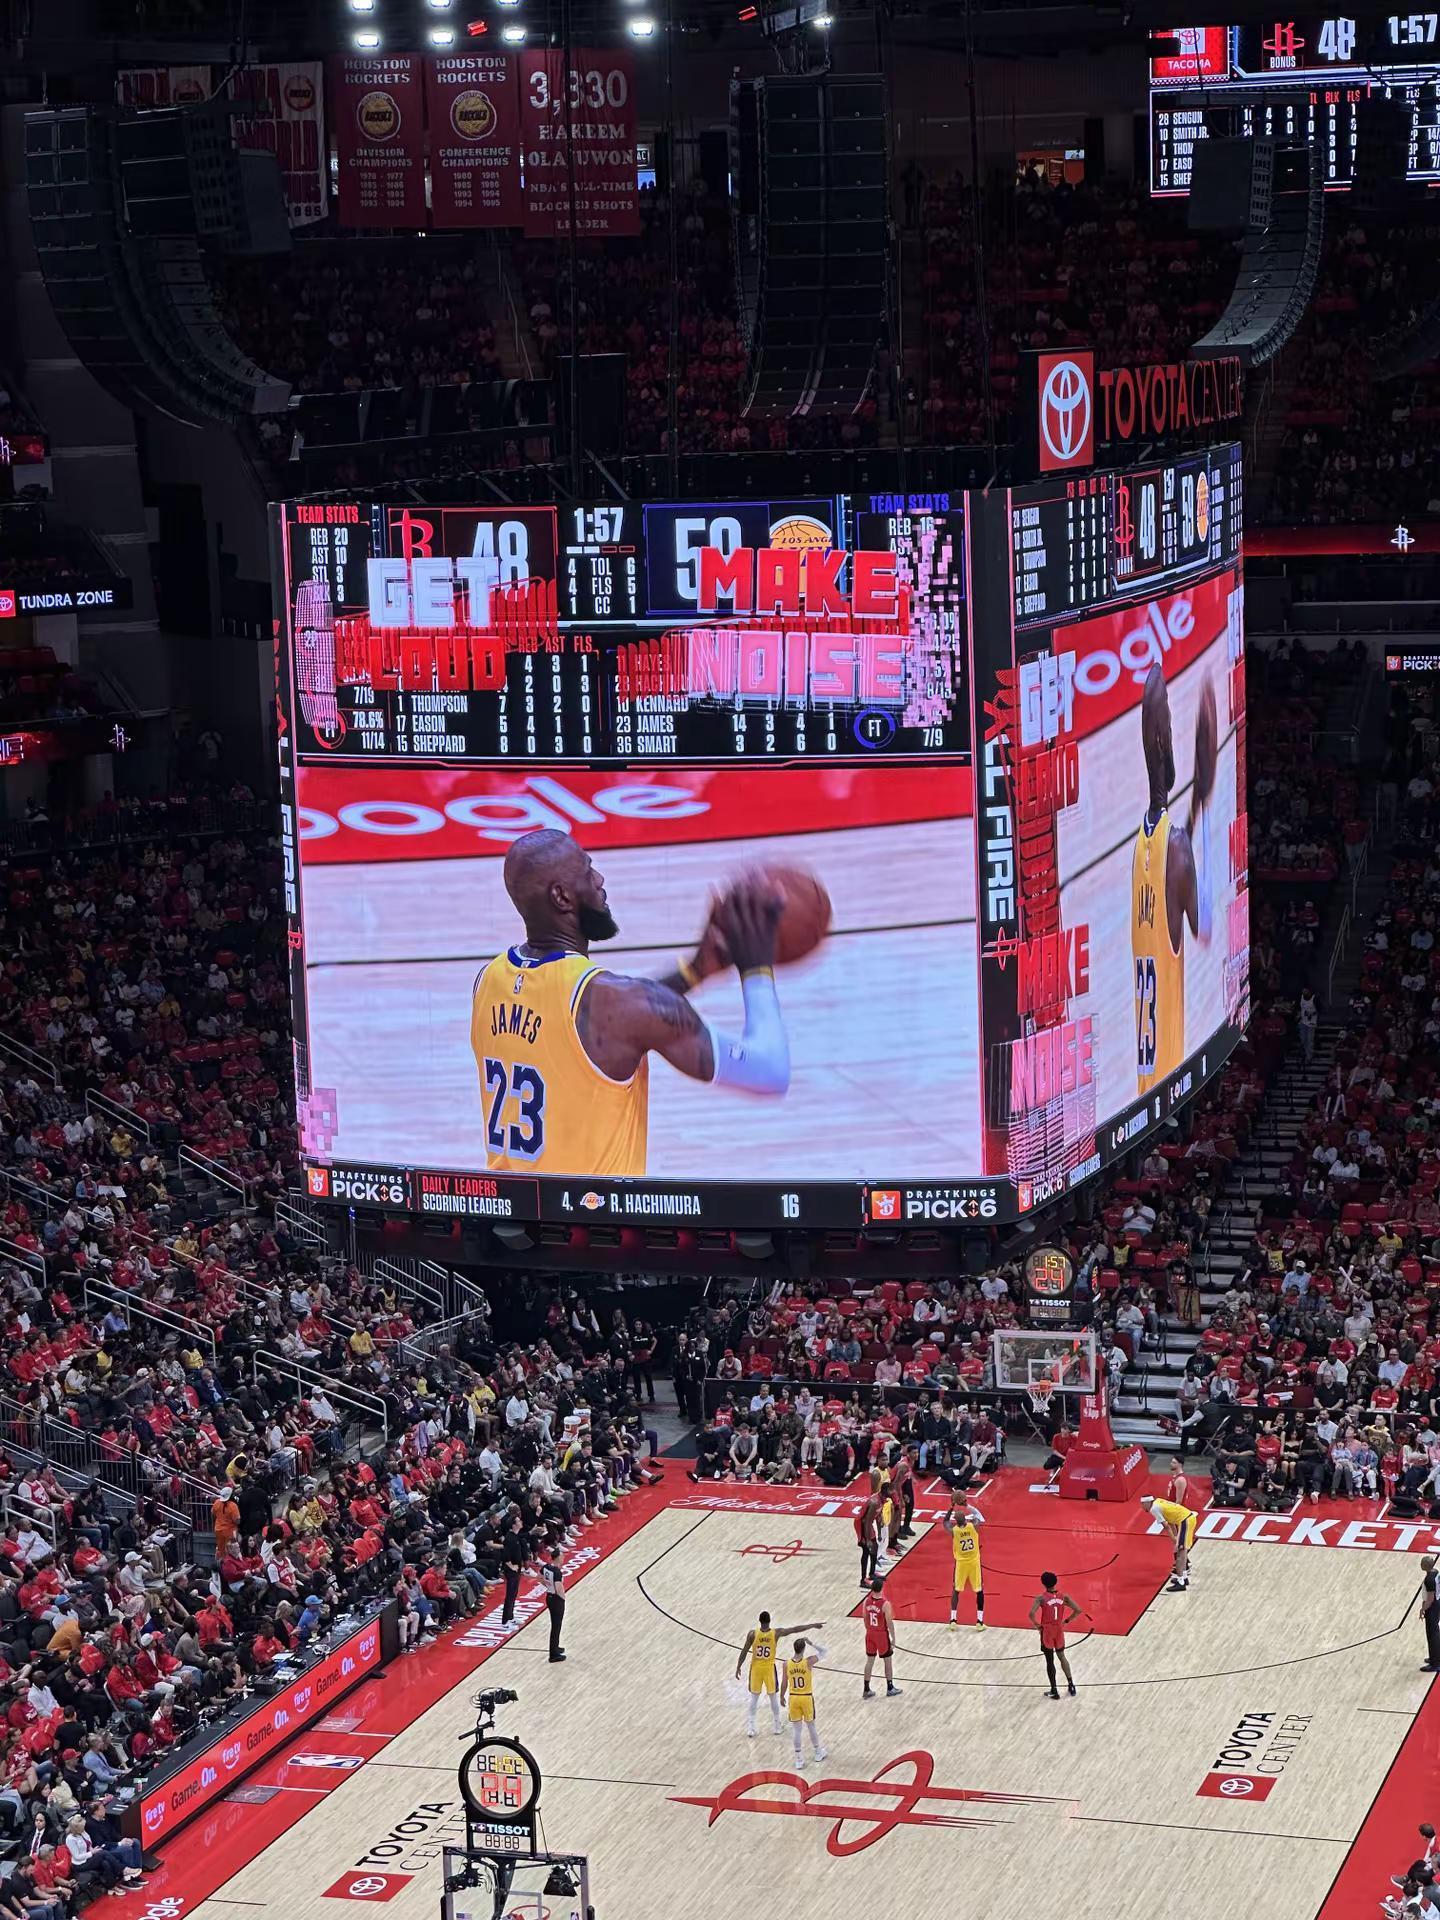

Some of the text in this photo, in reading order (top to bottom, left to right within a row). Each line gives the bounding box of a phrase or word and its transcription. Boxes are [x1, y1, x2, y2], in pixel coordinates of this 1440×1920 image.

[1318, 14, 1438, 60] 48 1:57
[344, 59, 411, 70] HOUSTON
[436, 57, 506, 70] HOUSTON
[1168, 59, 1211, 69] TACOMA
[1270, 56, 1296, 68] BONUS
[345, 73, 411, 84] ROCKETS
[437, 72, 506, 84] ROCKETS
[538, 123, 625, 140] HAKEEM
[1173, 126, 1197, 140] SMITH
[356, 148, 405, 157] DIVISION
[439, 146, 511, 157] CONFERENCE
[349, 158, 413, 167] CHAMPIONS
[442, 157, 509, 168] CHAMPIONS
[593, 200, 634, 211] SHOTS
[1099, 356, 1242, 441] TOYOTA CENTER
[870, 494, 950, 514] TEAM STATS
[297, 506, 359, 523] TEAM STATS
[1140, 483, 1156, 560] 48
[573, 507, 624, 542] 1:57
[888, 517, 912, 536] REB
[310, 527, 349, 546] REB 20
[311, 546, 348, 564] AST 10
[312, 565, 344, 583] STL 3
[567, 557, 636, 576] 4 TOL 6
[568, 576, 636, 595] 4 FLS 5
[696, 546, 901, 619] MAKE
[19, 590, 113, 610] TUNDRA ZONE
[337, 584, 345, 602] 3
[366, 557, 499, 628] GET
[570, 596, 636, 615] 1 CC 1
[545, 636, 593, 653] AST FLS
[367, 636, 507, 691] LOUD
[524, 655, 588, 673] 4 3 1
[688, 628, 908, 704] NOISE
[1403, 660, 1433, 671] PICK
[525, 675, 590, 693] 2 0 3
[353, 686, 375, 704] 7/19
[398, 695, 590, 713] 1 THOMPSON 7 3 2 0
[636, 694, 690, 713] KENNARD
[352, 711, 384, 729] 78.6%
[396, 714, 590, 733] 17 EASON 5 4 1 1
[616, 712, 834, 733] 23 JAMES 14 3 4 1
[868, 719, 881, 737] FT
[361, 731, 385, 750] 11/14
[396, 734, 592, 753] 15 SHEPPARD 8 0 3 0
[616, 733, 836, 753] 36 SMART 3 2 6 0
[923, 729, 943, 746] 7/9
[986, 805, 1015, 921] FIRE
[1017, 923, 1090, 1016] MAKE
[490, 1002, 542, 1045] JAMES
[1136, 956, 1157, 1076] 23
[1012, 1015, 1093, 1113] NOISE
[483, 1056, 547, 1162] 23
[332, 1170, 403, 1184] DRAFTKINGS
[422, 1175, 497, 1197] DAILY LEADERS
[332, 1181, 379, 1202] PICK
[906, 1188, 996, 1199] DRAFTKINGS
[422, 1193, 512, 1217] SCORING LEADERS
[561, 1191, 574, 1211] 4.
[624, 1193, 701, 1215] HACHIMURA
[781, 1193, 800, 1218] 16
[906, 1199, 968, 1219] PICK
[1034, 1267, 1064, 1292] 24
[669, 1495, 811, 1513] Michelob
[960, 1538, 975, 1552] 23
[869, 1612, 878, 1627] 15
[1054, 1606, 1058, 1620] 1
[756, 1645, 771, 1658] 36
[316, 1657, 355, 1696] Game. On.
[793, 1676, 805, 1689] 10
[246, 1710, 290, 1752] Game. On.
[1212, 1711, 1277, 1770] TOYOTA
[1256, 1713, 1314, 1774] CENTER
[171, 1765, 218, 1811] Game. On.
[354, 1801, 454, 1867] TOYOTA
[486, 1823, 530, 1836] TISSOT
